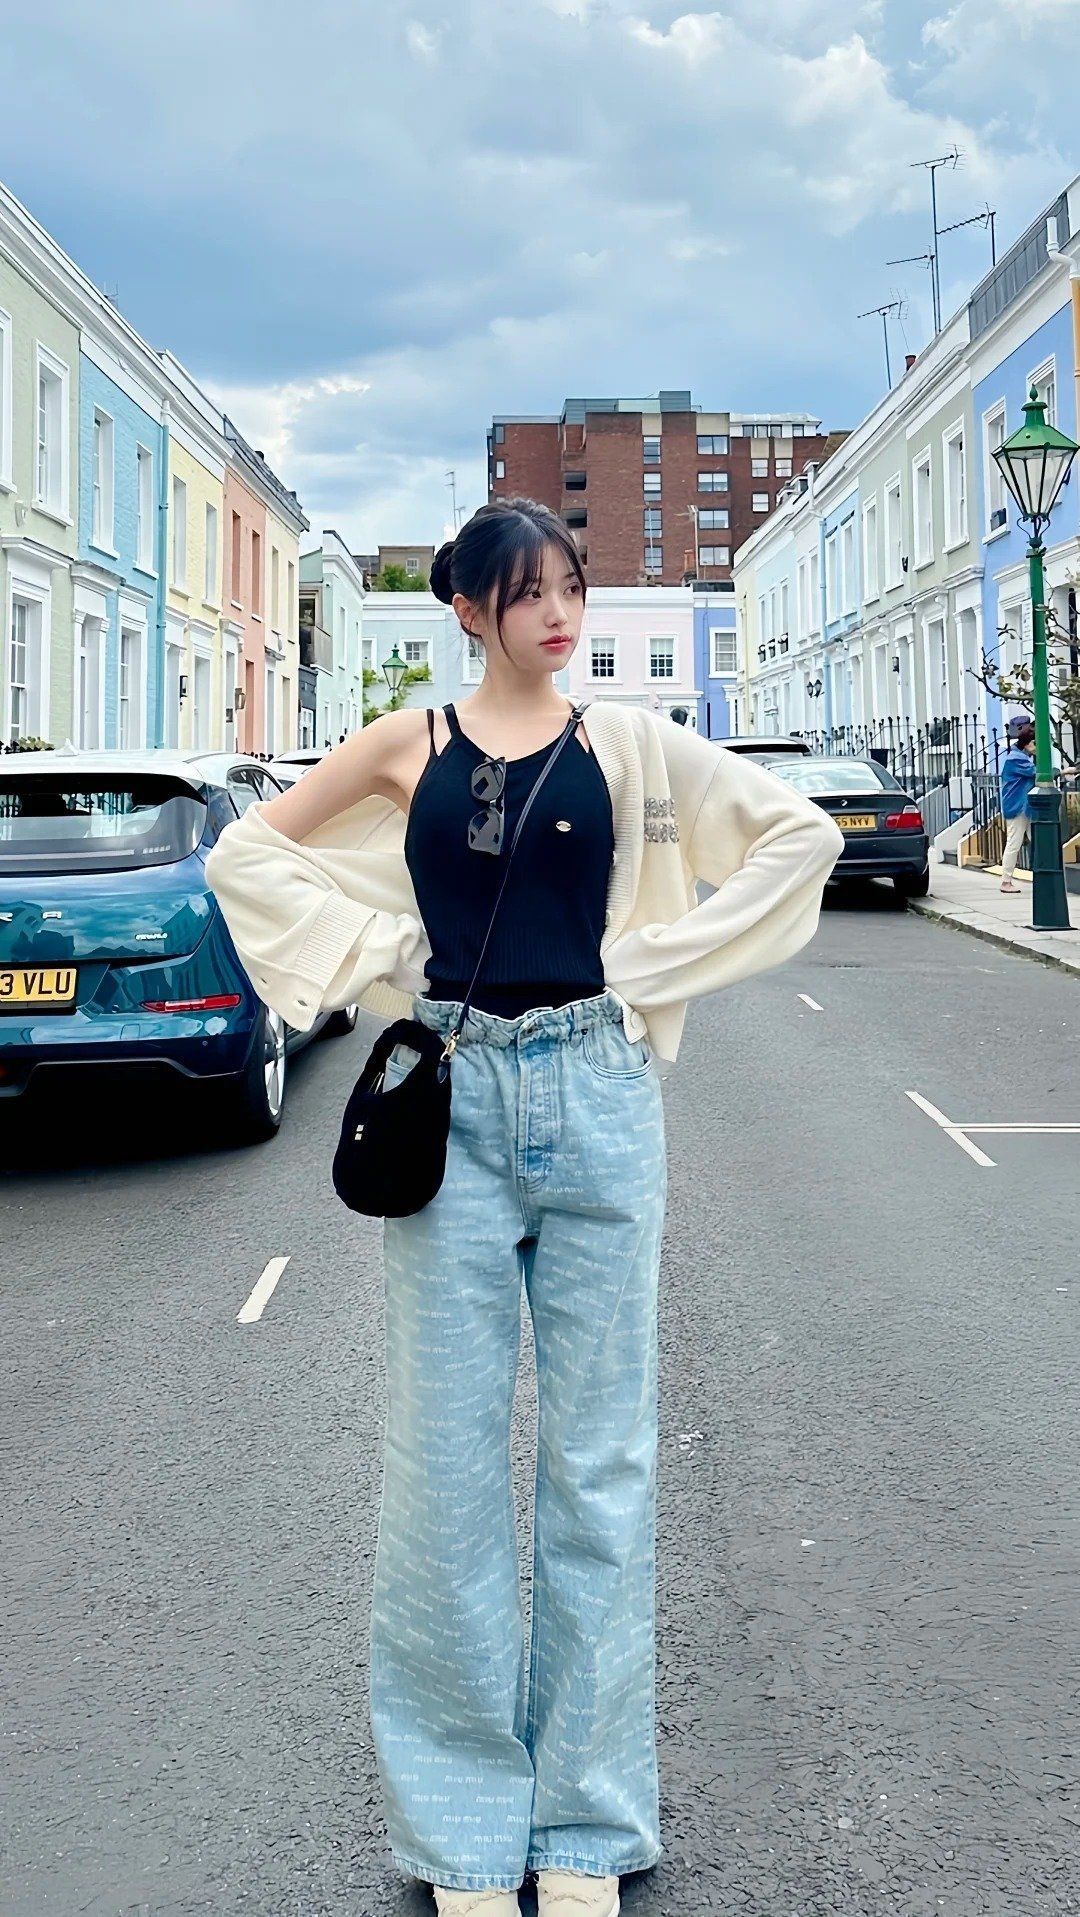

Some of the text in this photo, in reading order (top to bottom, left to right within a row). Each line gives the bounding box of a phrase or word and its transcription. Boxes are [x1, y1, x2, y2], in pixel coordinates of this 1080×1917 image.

[850, 817, 869, 826] NYV
[0, 971, 71, 996] 3 VLU
